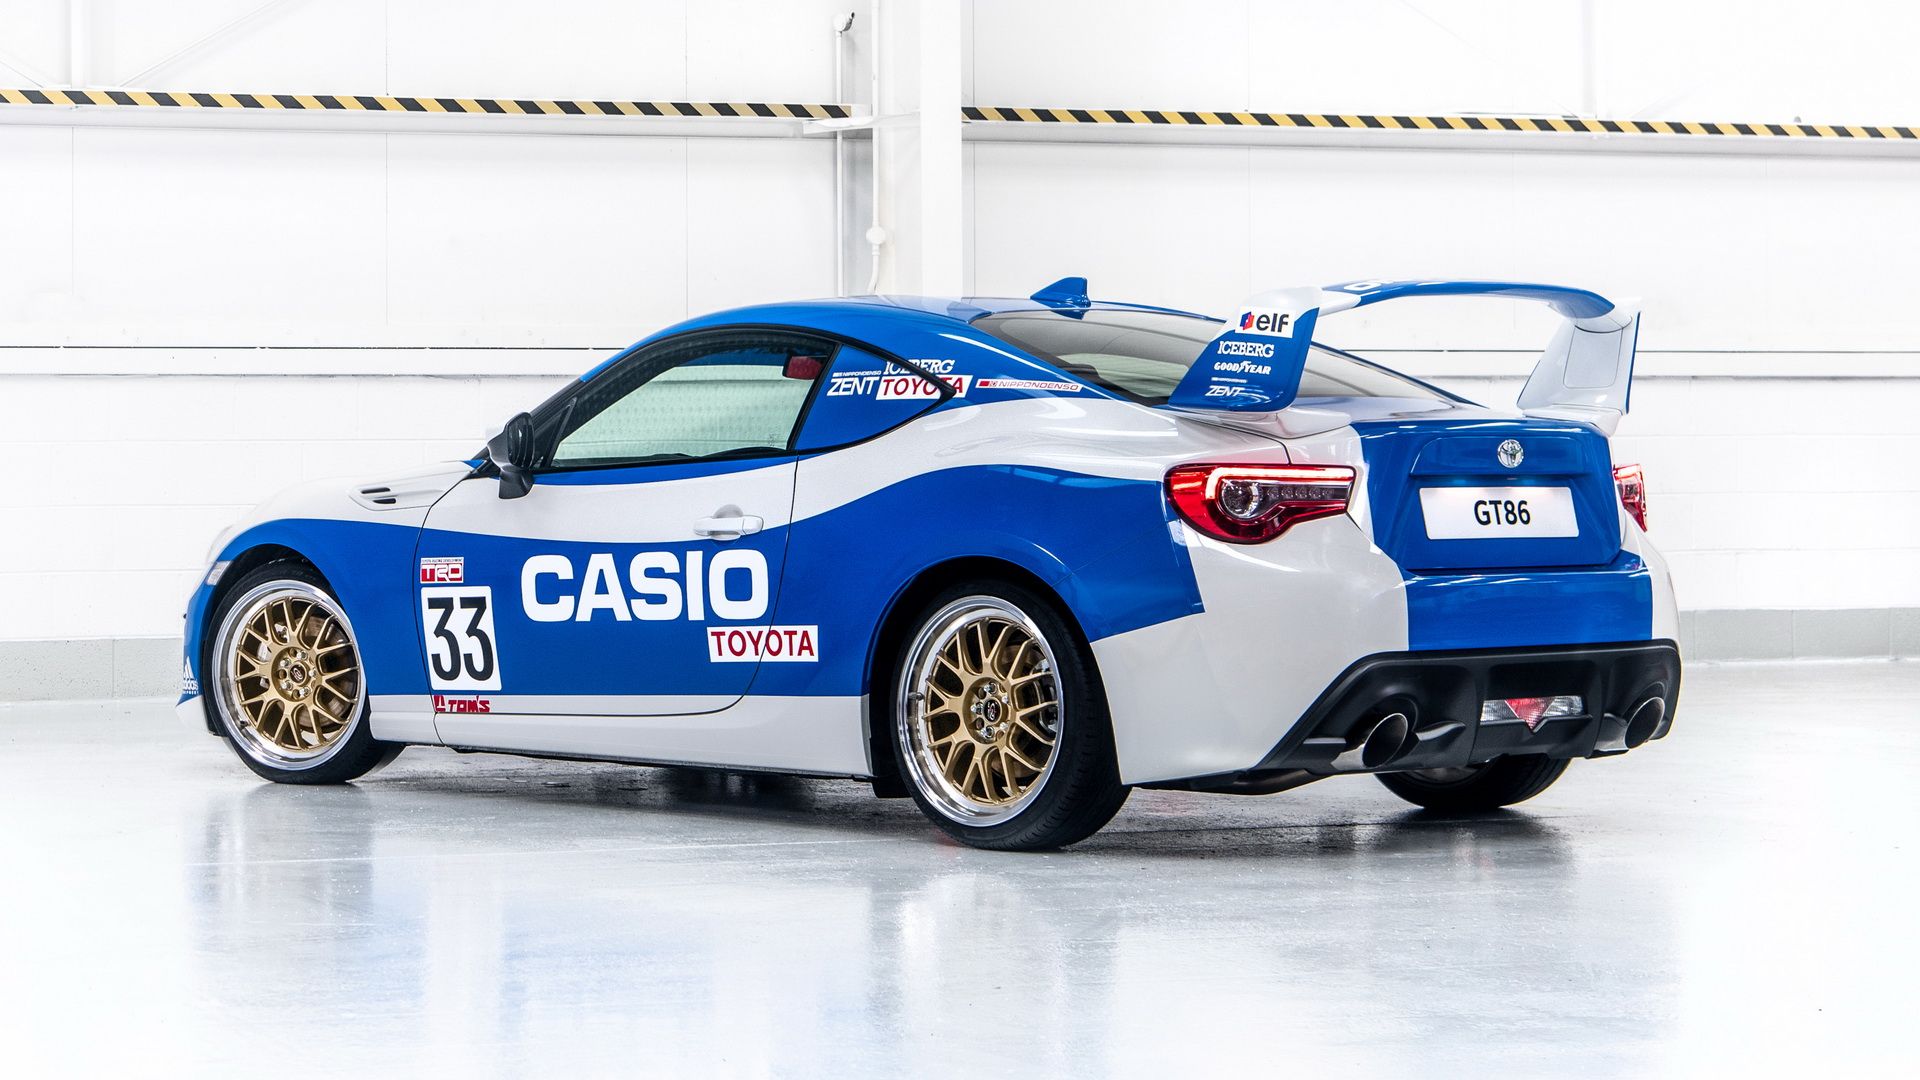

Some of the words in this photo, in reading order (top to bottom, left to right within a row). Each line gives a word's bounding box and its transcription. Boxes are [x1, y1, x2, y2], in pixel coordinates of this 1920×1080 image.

[1256, 313, 1290, 333] elf
[1217, 340, 1276, 358] ICEBERG
[1213, 360, 1272, 375] GOODYEAR
[826, 376, 880, 396] ZENT
[998, 380, 1079, 391] NIPPONDENSO
[1204, 385, 1246, 397] ZENT
[1473, 500, 1531, 526] GT86
[420, 564, 463, 583] TRD
[520, 549, 769, 623] CASIO
[427, 596, 494, 681] 33
[710, 629, 815, 657] TOYOTA
[447, 695, 490, 713] TOM'S
